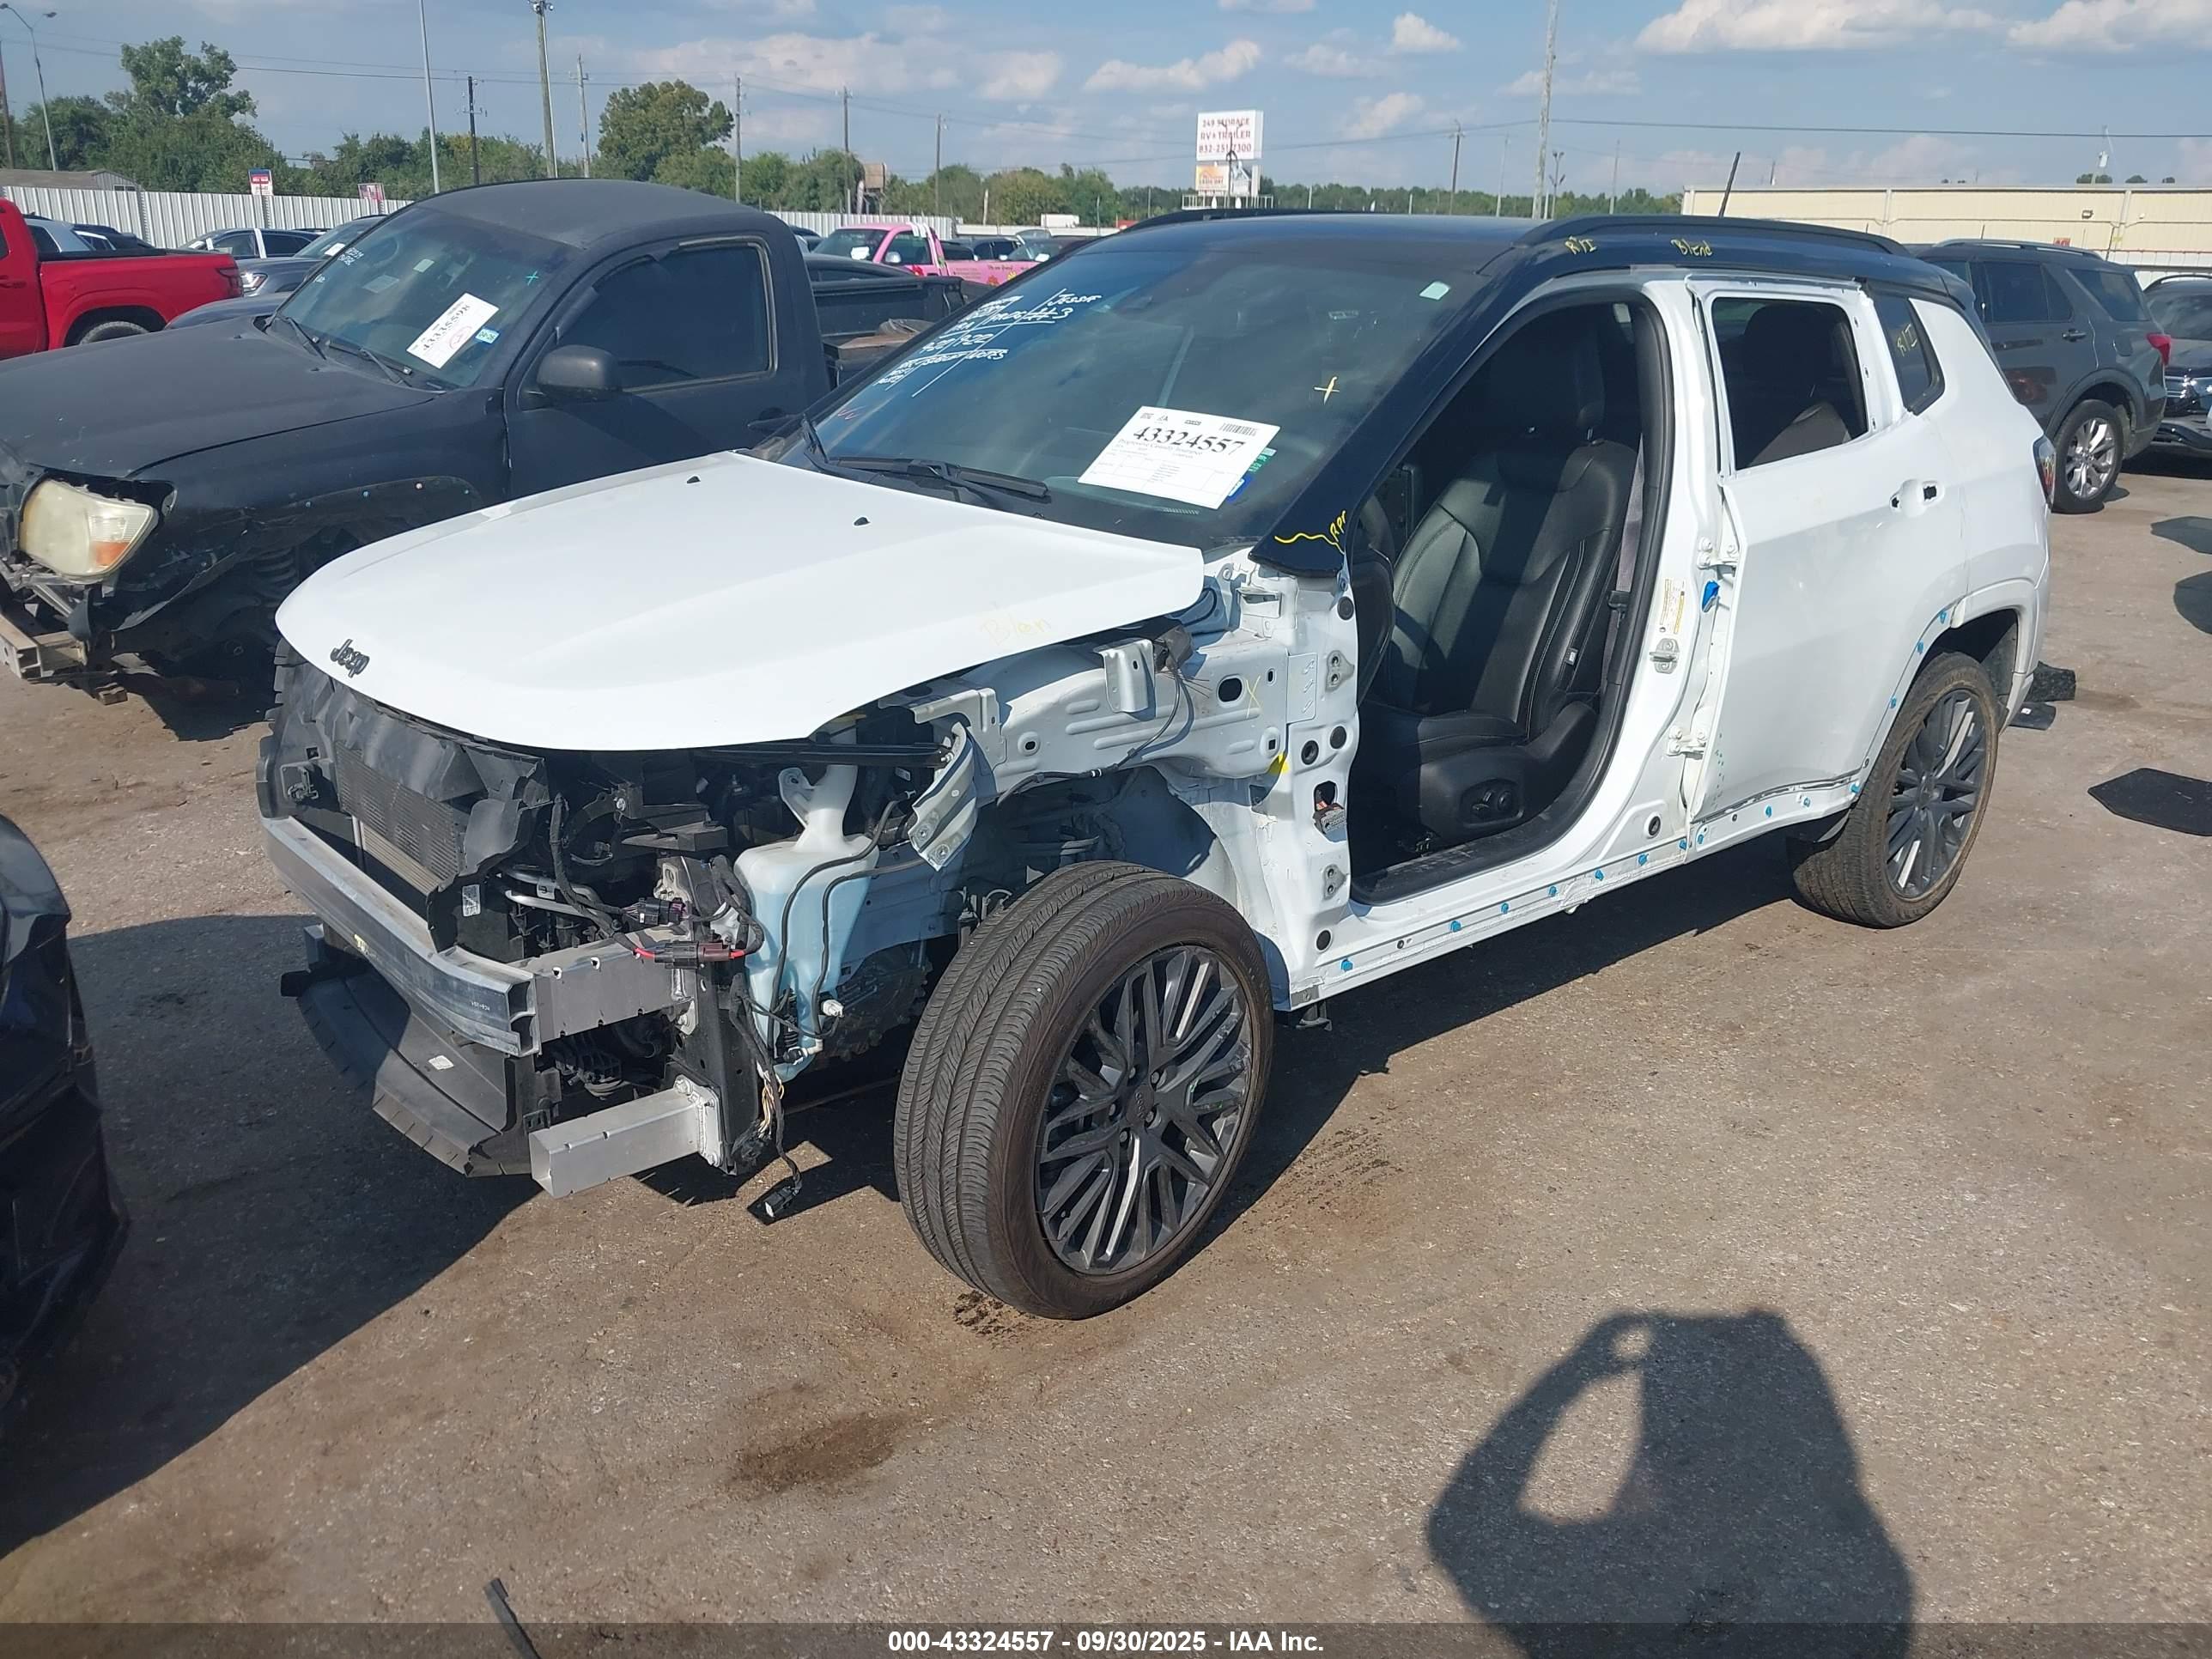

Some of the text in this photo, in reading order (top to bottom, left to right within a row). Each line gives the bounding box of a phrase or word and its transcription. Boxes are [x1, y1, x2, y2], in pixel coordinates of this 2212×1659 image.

[1670, 238, 1713, 257] Blend
[1133, 426, 1247, 456] 43324557
[330, 638, 370, 678] Jeep
